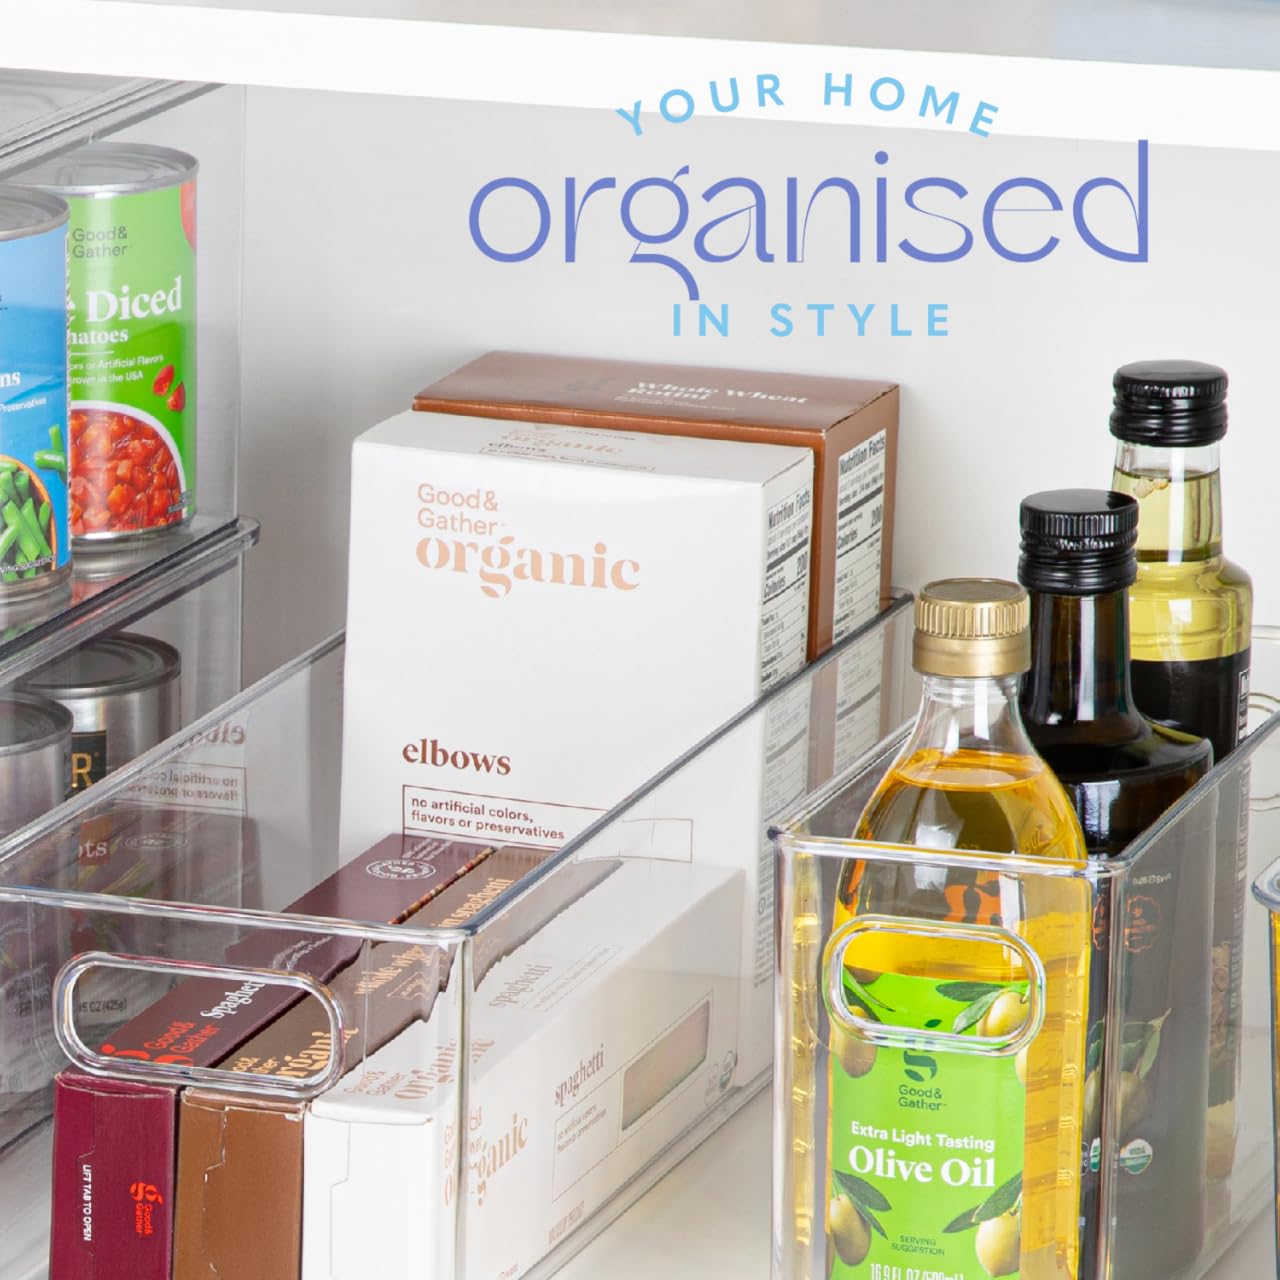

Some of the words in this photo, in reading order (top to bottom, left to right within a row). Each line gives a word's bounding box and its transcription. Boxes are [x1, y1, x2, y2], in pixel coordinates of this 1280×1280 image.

[73, 244, 126, 259] Gather
[86, 276, 182, 322] Diced
[126, 371, 143, 380] USA
[869, 435, 885, 459] Facts
[417, 508, 498, 535] Gather
[415, 536, 640, 598] organic
[403, 738, 512, 776] elbows
[412, 798, 427, 808] no
[431, 800, 485, 816] artificial
[489, 807, 534, 823] colors,
[412, 810, 455, 827] flavors
[459, 819, 471, 828] or
[476, 820, 565, 840] preservatives
[488, 963, 552, 1008] spaghetti
[170, 1024, 219, 1053] Gather
[555, 1043, 604, 1107] spaghetti
[898, 1097, 942, 1111] Gather
[850, 1121, 888, 1141] Extra
[892, 1127, 931, 1147] Light
[936, 1132, 995, 1152] Tasting
[848, 1145, 933, 1184] Olive
[940, 1155, 996, 1188] Oil
[83, 1184, 92, 1201] TAB
[83, 1201, 92, 1215] TO
[83, 1216, 92, 1241] OPEN
[899, 1235, 936, 1246] SERVING
[891, 1243, 945, 1256] SUGGESTION
